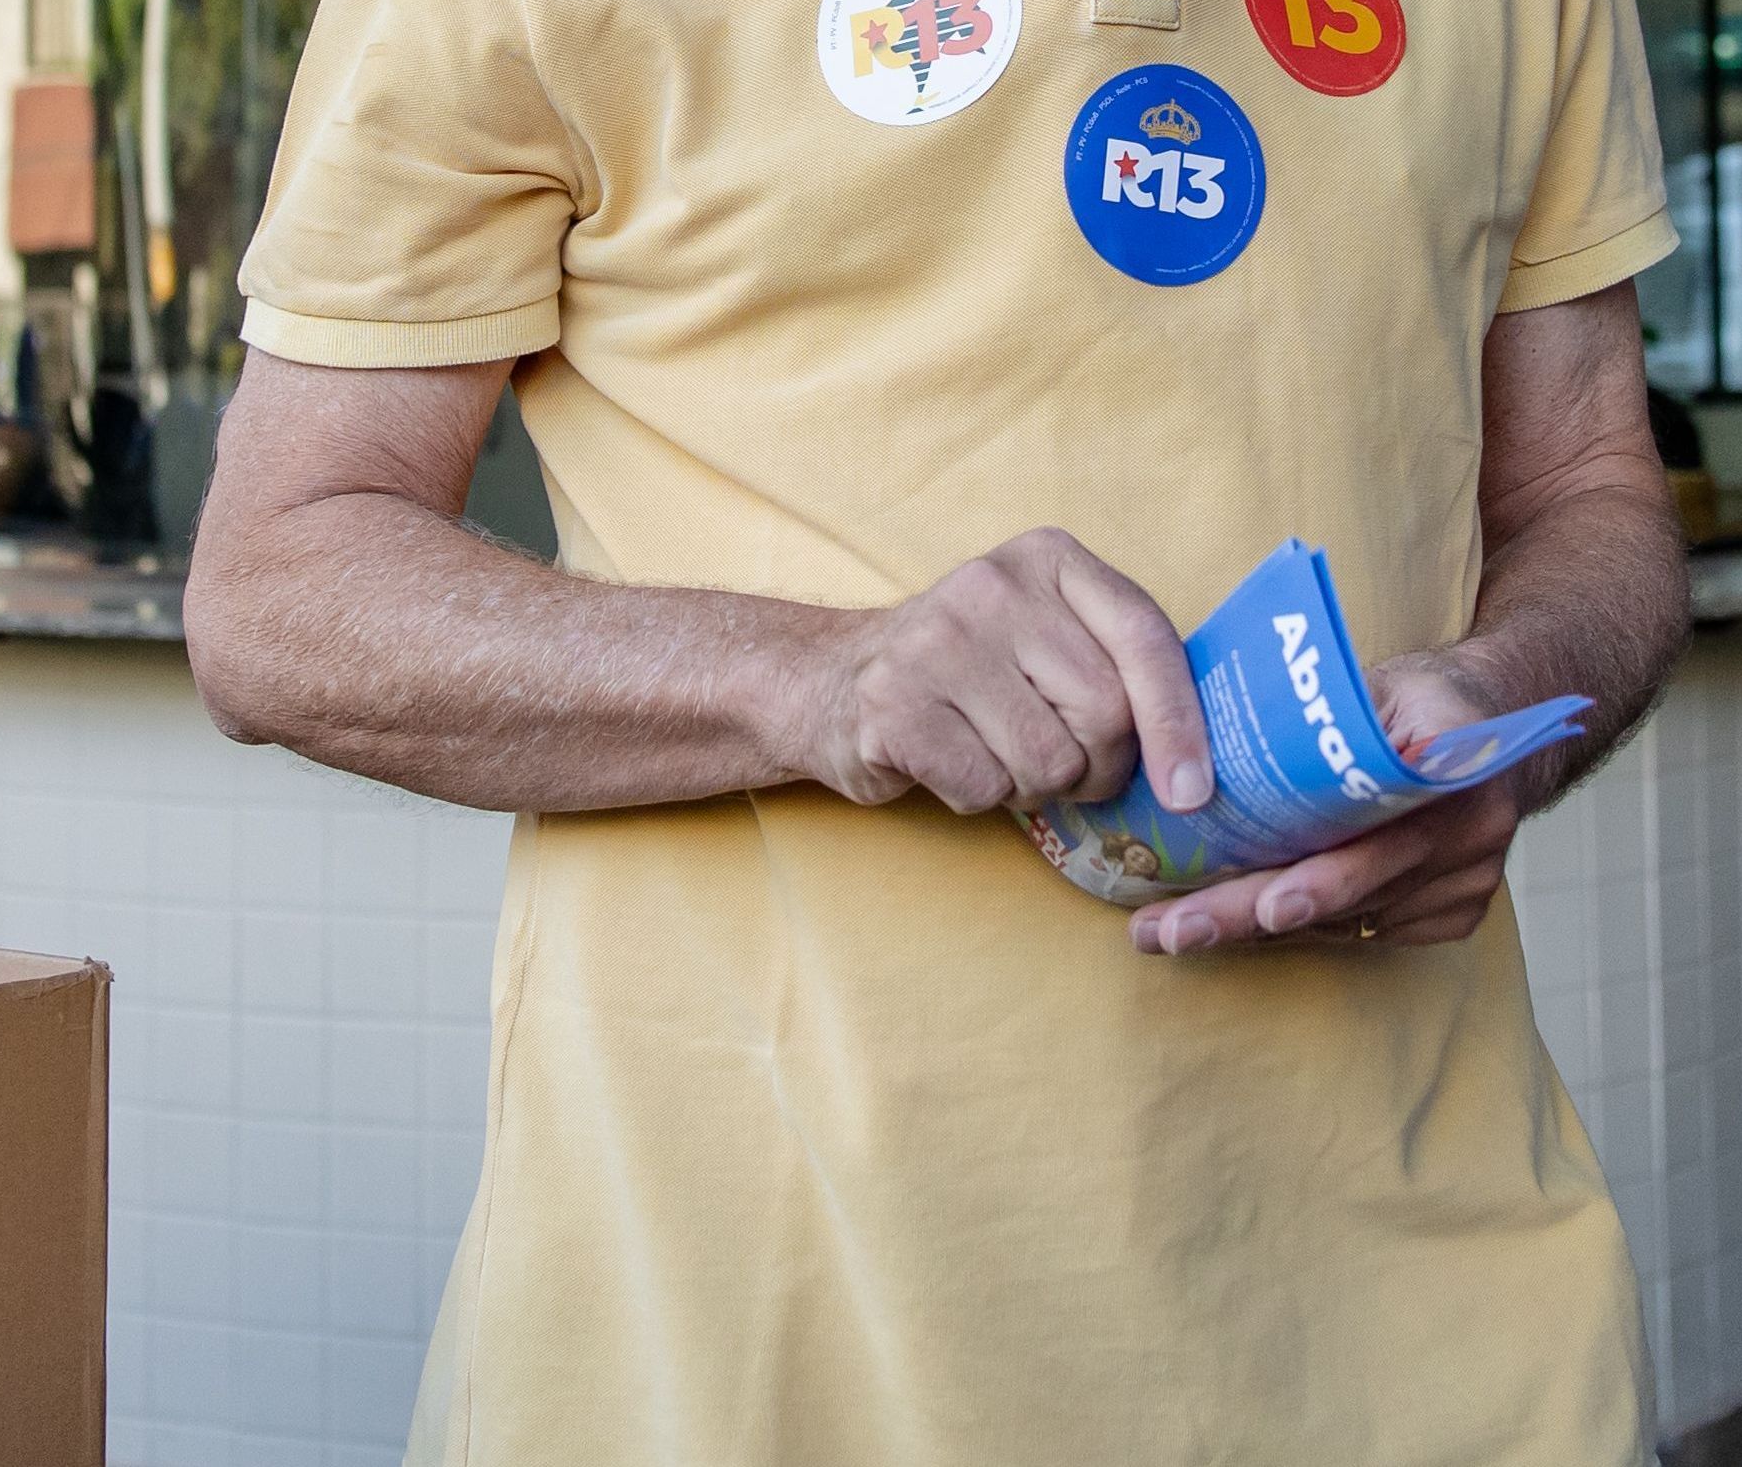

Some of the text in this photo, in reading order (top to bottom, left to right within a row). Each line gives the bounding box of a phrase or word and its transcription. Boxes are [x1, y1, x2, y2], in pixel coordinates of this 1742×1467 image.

[1098, 96, 1115, 110] PSOL
[1115, 84, 1132, 96] Rede
[1135, 76, 1148, 86] PCB
[1102, 138, 1226, 220] R13
